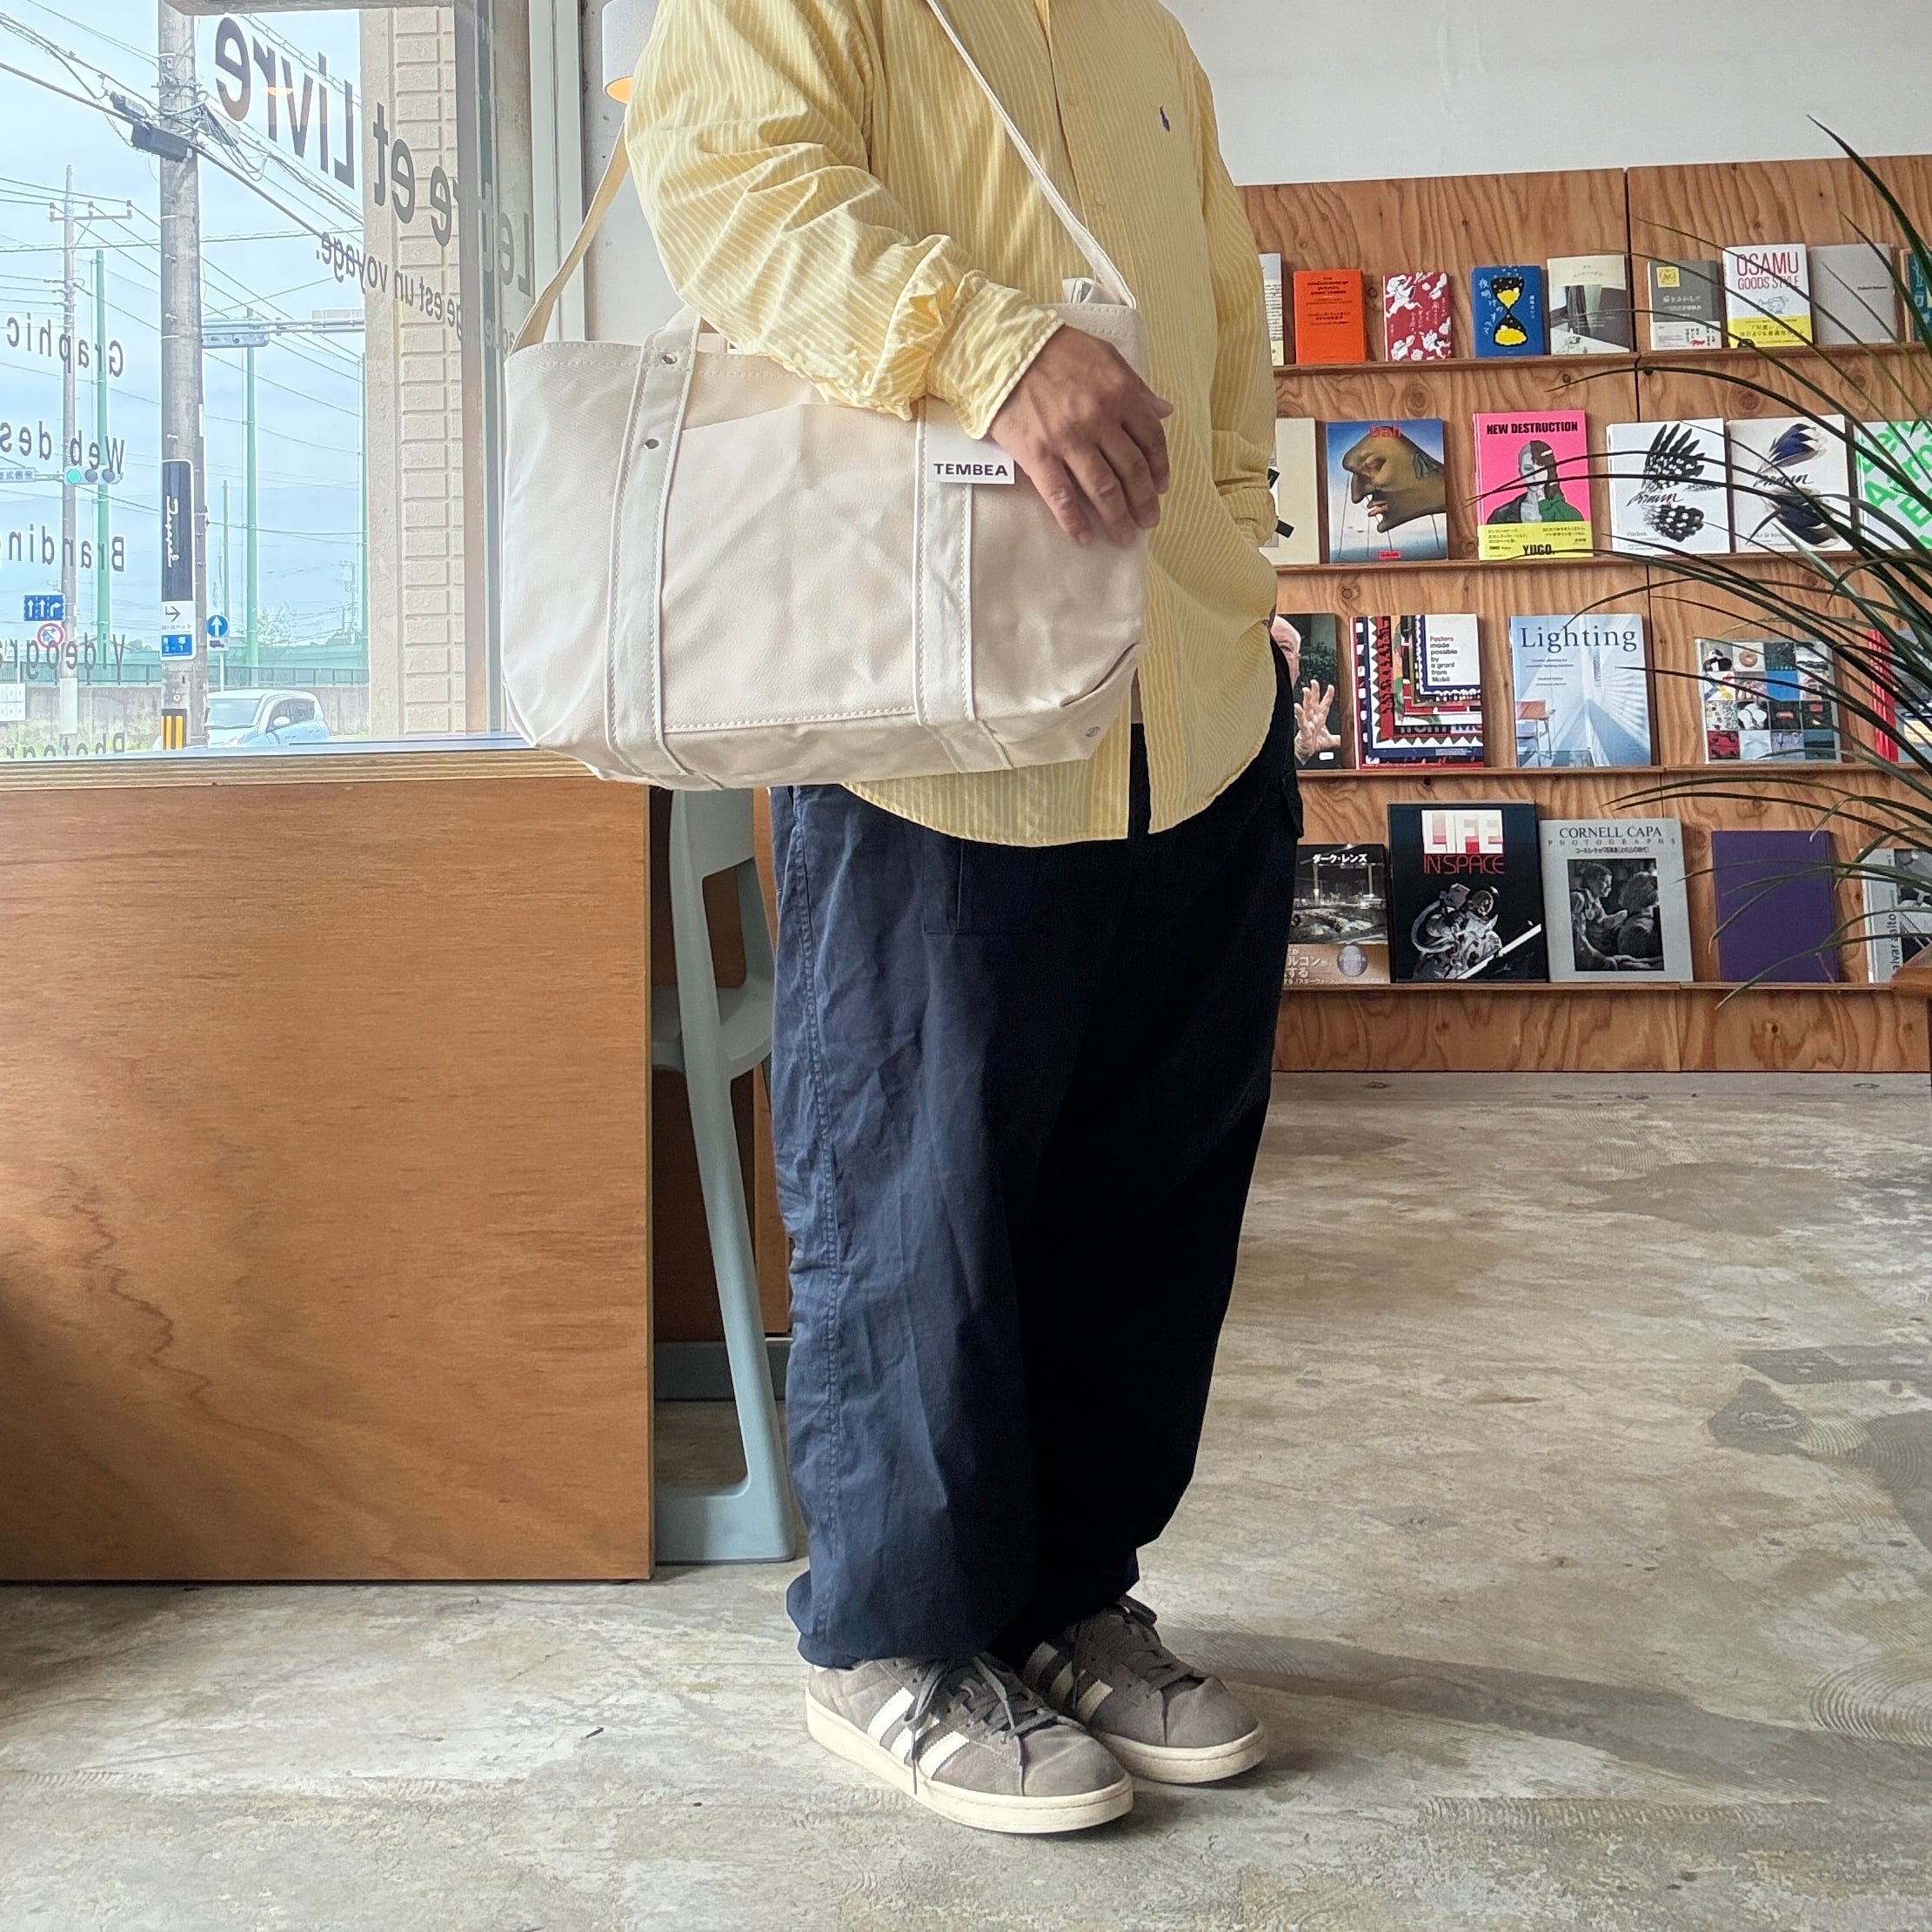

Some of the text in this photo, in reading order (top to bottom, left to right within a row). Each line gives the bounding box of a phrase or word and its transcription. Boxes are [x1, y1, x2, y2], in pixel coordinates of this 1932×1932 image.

[1736, 251, 1799, 276] OSAMU
[1738, 275, 1800, 291] GOODS STE
[1487, 421, 1578, 435] NEW DESTRUCTION
[933, 463, 1008, 477] TEMBEA
[1521, 625, 1637, 653] Lighting
[1422, 810, 1503, 854] LIFE
[1560, 826, 1662, 839] CORNELL CAPA
[1313, 853, 1367, 864] ダーク・レンズ
